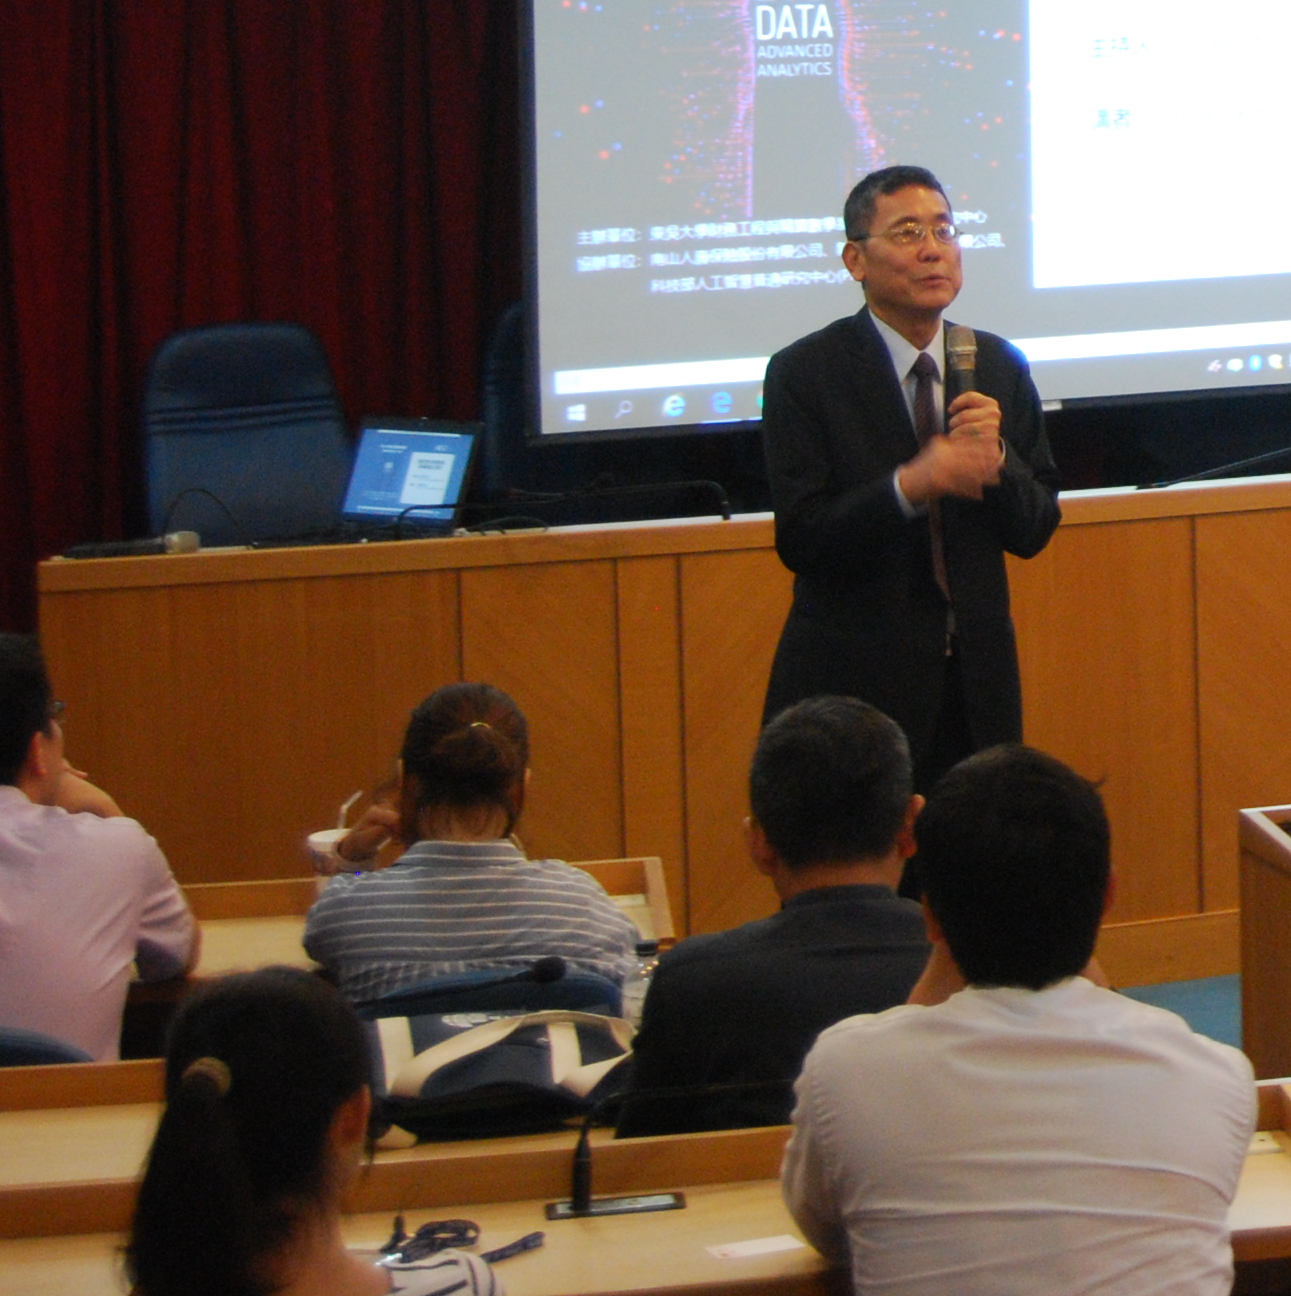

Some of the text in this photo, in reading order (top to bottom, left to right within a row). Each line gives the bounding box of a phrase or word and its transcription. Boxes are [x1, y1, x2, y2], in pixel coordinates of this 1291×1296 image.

[755, 4, 834, 40] DATA
[756, 43, 833, 59] ADVANCED
[756, 61, 833, 77] ANALYTICS
